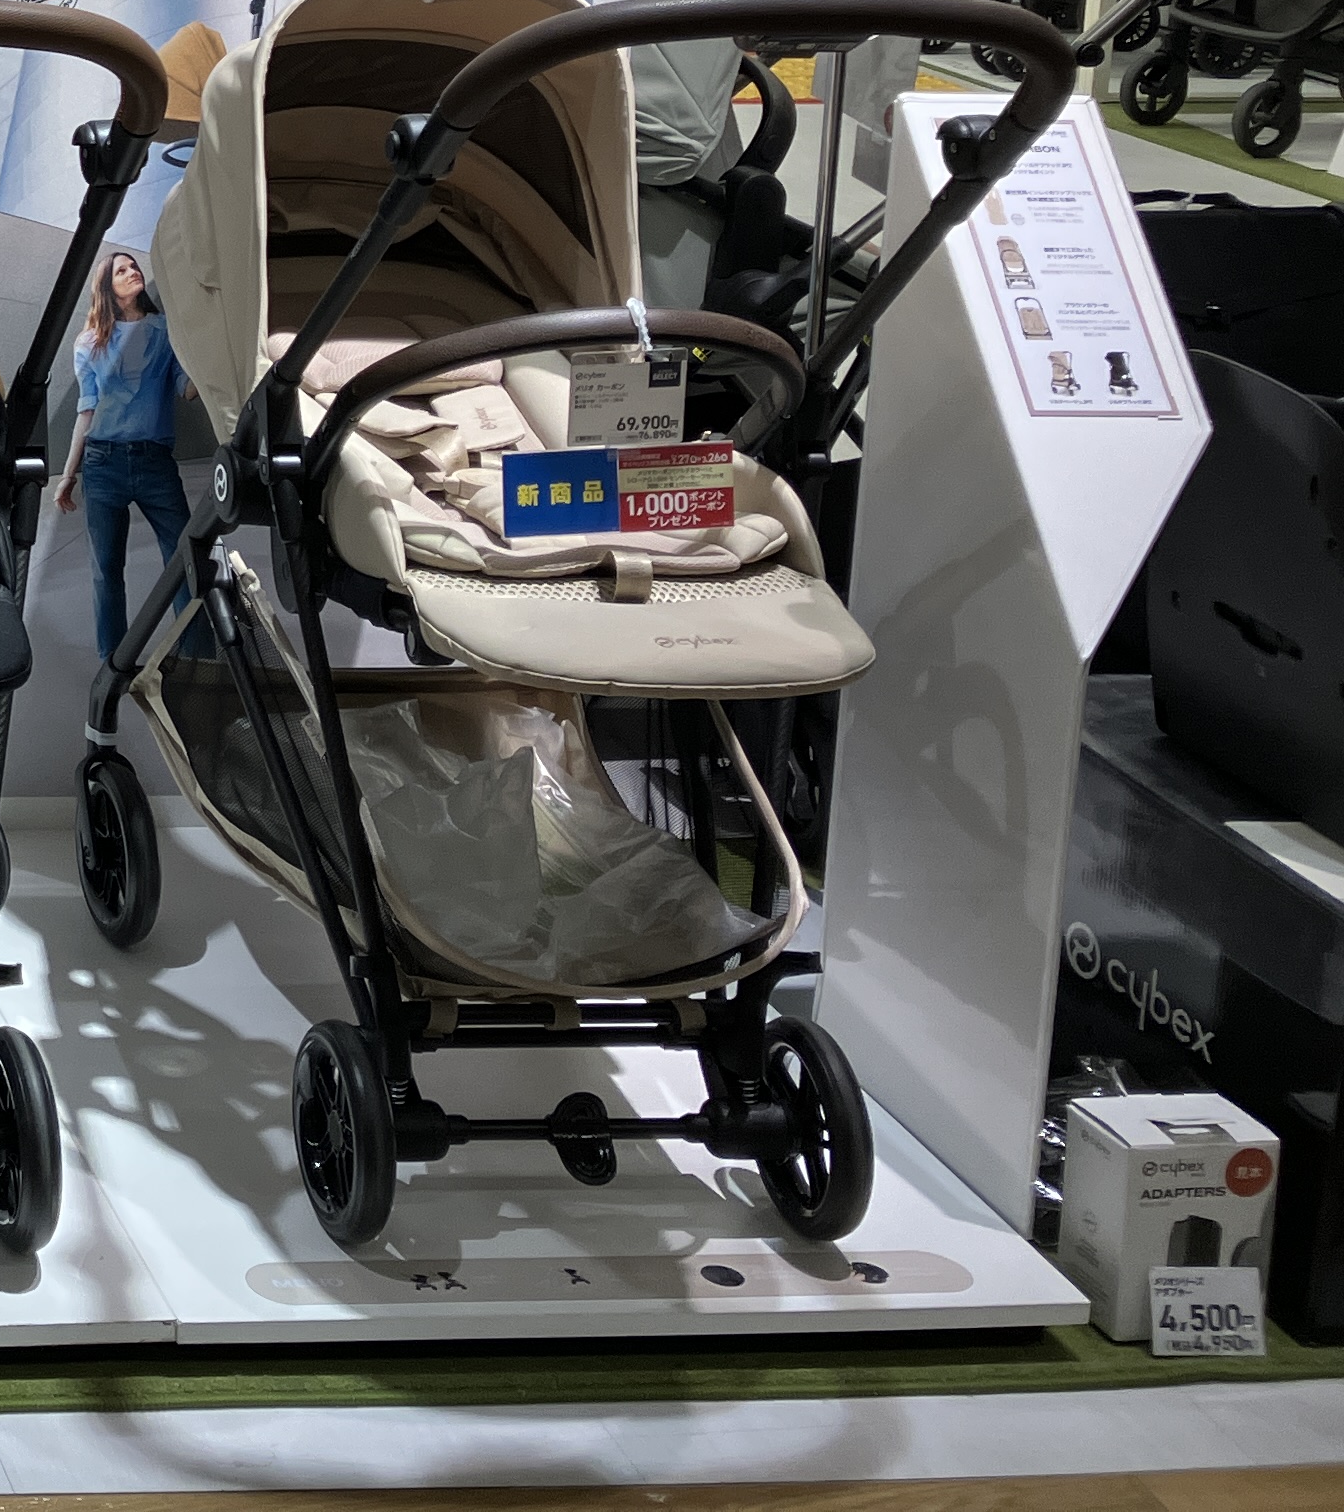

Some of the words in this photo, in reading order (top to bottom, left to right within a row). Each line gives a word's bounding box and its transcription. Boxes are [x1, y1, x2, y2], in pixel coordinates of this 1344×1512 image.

[617, 415, 678, 431] 69,900円
[517, 480, 604, 507] 新商品
[626, 492, 688, 516] 1,000
[689, 491, 724, 501] ポイント
[690, 502, 725, 512] クーポン
[648, 515, 701, 528] プレゼント
[674, 636, 736, 649] cybex
[1106, 958, 1215, 1063] cybex
[1160, 1160, 1204, 1176] cybex
[1141, 1187, 1226, 1200] ADAPTERS
